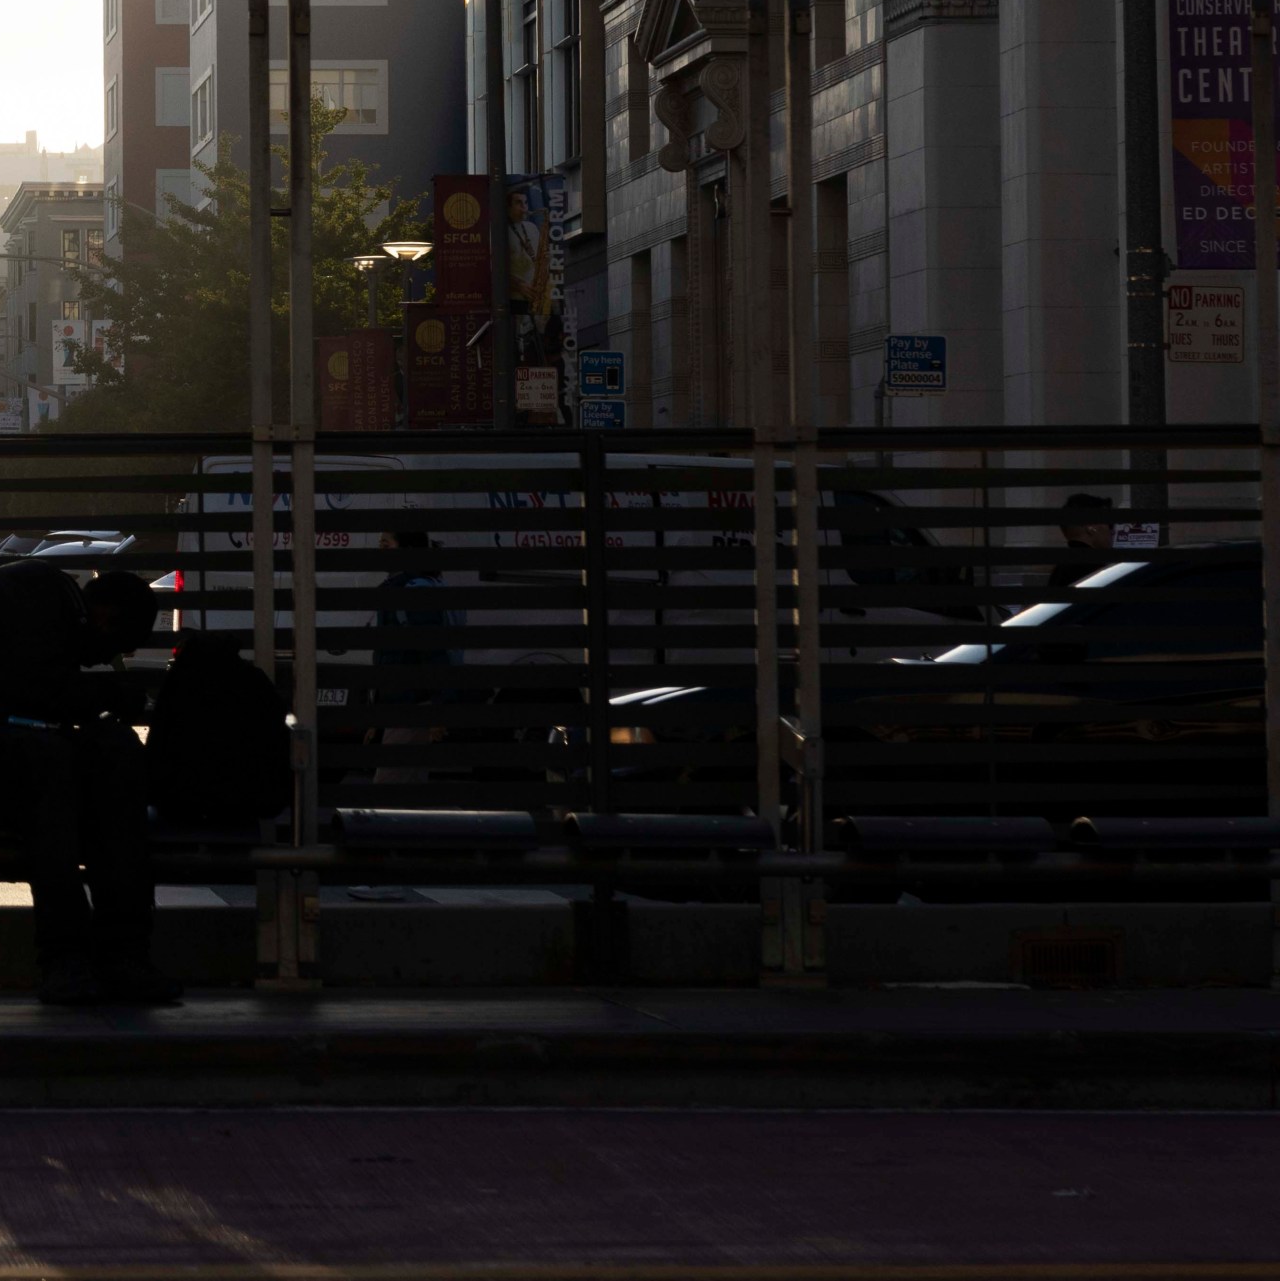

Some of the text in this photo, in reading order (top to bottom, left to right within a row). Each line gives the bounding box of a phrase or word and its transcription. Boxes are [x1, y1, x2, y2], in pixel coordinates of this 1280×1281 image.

[1178, 67, 1253, 103] CENT
[1191, 140, 1256, 153] FOUNDE
[1201, 162, 1256, 175] ARTIST
[1183, 207, 1208, 220] ED
[443, 233, 481, 243] SFCM
[548, 189, 565, 300] PERFORM
[1200, 240, 1247, 253] SINCE
[1171, 287, 1240, 308] NO PARKING
[1176, 312, 1184, 326] 2
[1215, 314, 1222, 327] 6
[890, 337, 929, 350] Pay by
[1170, 333, 1240, 346] TUES THURS
[890, 348, 933, 359] License
[1175, 352, 1200, 360] STREET
[583, 355, 622, 367] Pay here
[890, 360, 920, 370] Plate
[518, 369, 556, 380] NO PARKING
[892, 373, 941, 383] 59000004
[583, 402, 613, 411] Pay by
[583, 410, 615, 419] License
[583, 419, 605, 427] Plate
[708, 489, 755, 510] HVA
